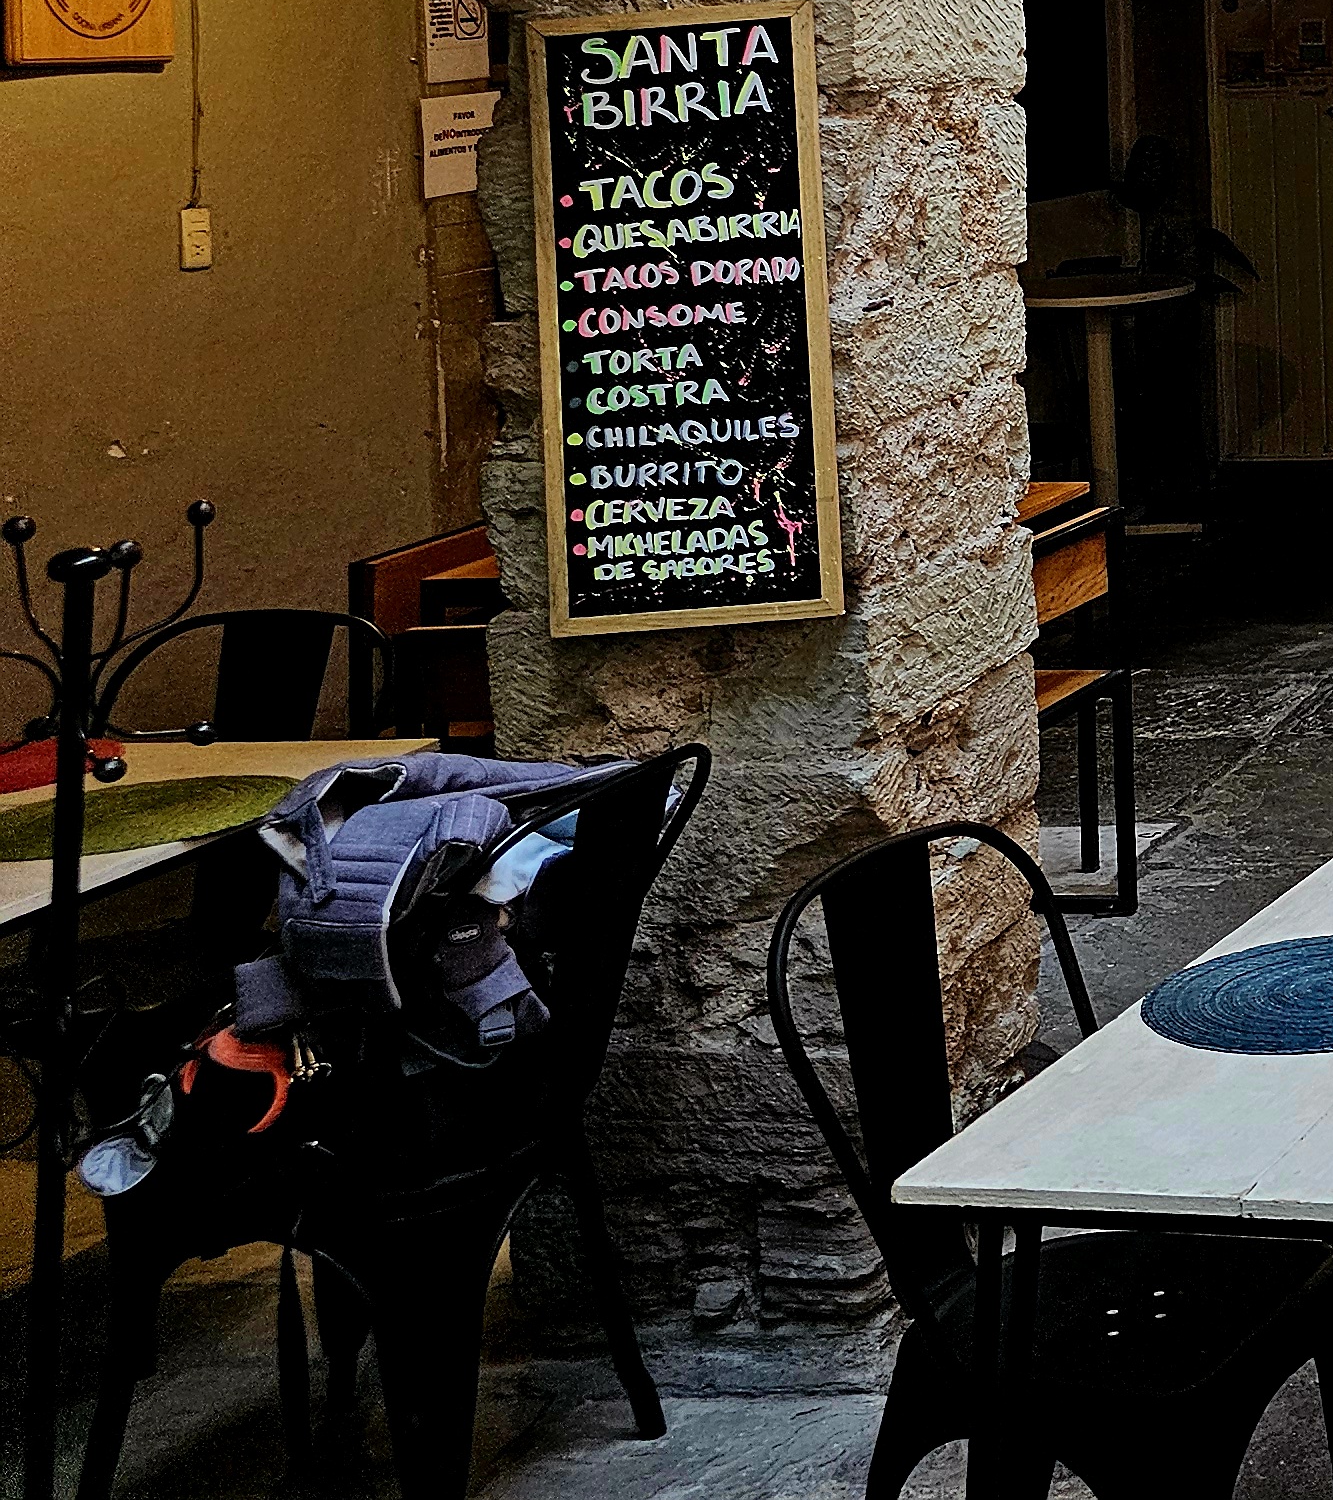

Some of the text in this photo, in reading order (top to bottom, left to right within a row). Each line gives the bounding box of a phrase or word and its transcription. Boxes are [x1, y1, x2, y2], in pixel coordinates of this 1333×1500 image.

[581, 25, 778, 84] SANTA
[582, 71, 772, 129] BIRRIA
[579, 162, 734, 211] TACOS
[573, 209, 800, 258] QUESABIRRIA
[574, 257, 800, 293] TACOS DORADO
[578, 302, 747, 338] CONSOME
[582, 344, 703, 375] TORTA
[586, 379, 730, 414] COSTRA
[586, 412, 799, 450] CHILAQUILES
[590, 459, 743, 489] BURRITO
[585, 496, 736, 530] CERVEZA
[587, 520, 768, 559] MICHELADAS
[594, 549, 775, 580] DE SABORES
